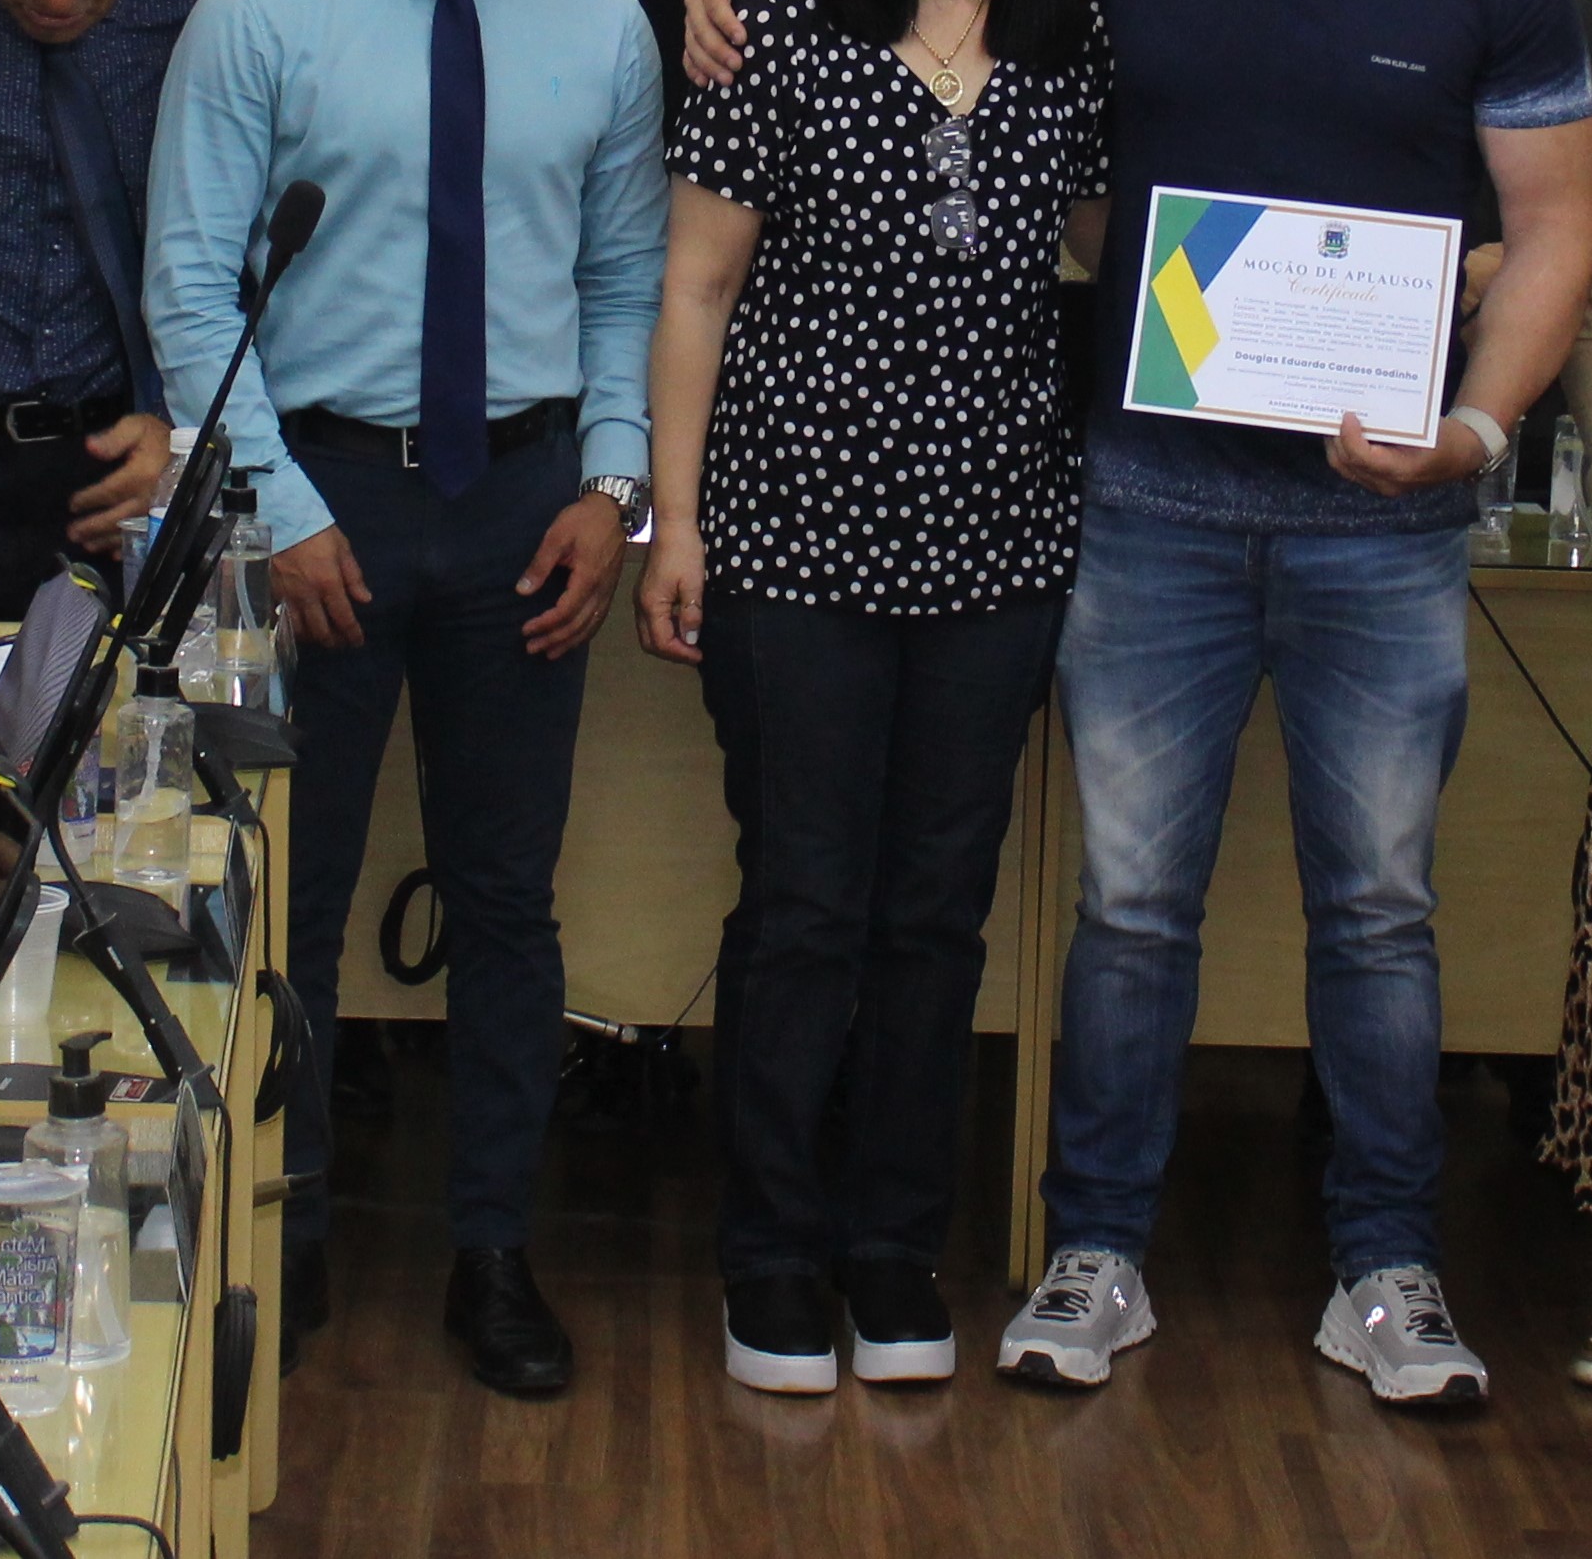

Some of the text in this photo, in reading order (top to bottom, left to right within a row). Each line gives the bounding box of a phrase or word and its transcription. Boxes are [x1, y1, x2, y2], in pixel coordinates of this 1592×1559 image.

[1243, 258, 1434, 291] MOÇÃO DE APLAUSOS
[1288, 276, 1380, 304] Certificado
[1234, 351, 1279, 364] Douglas
[1328, 361, 1373, 376] Cardoso
[1375, 367, 1419, 382] Godinho
